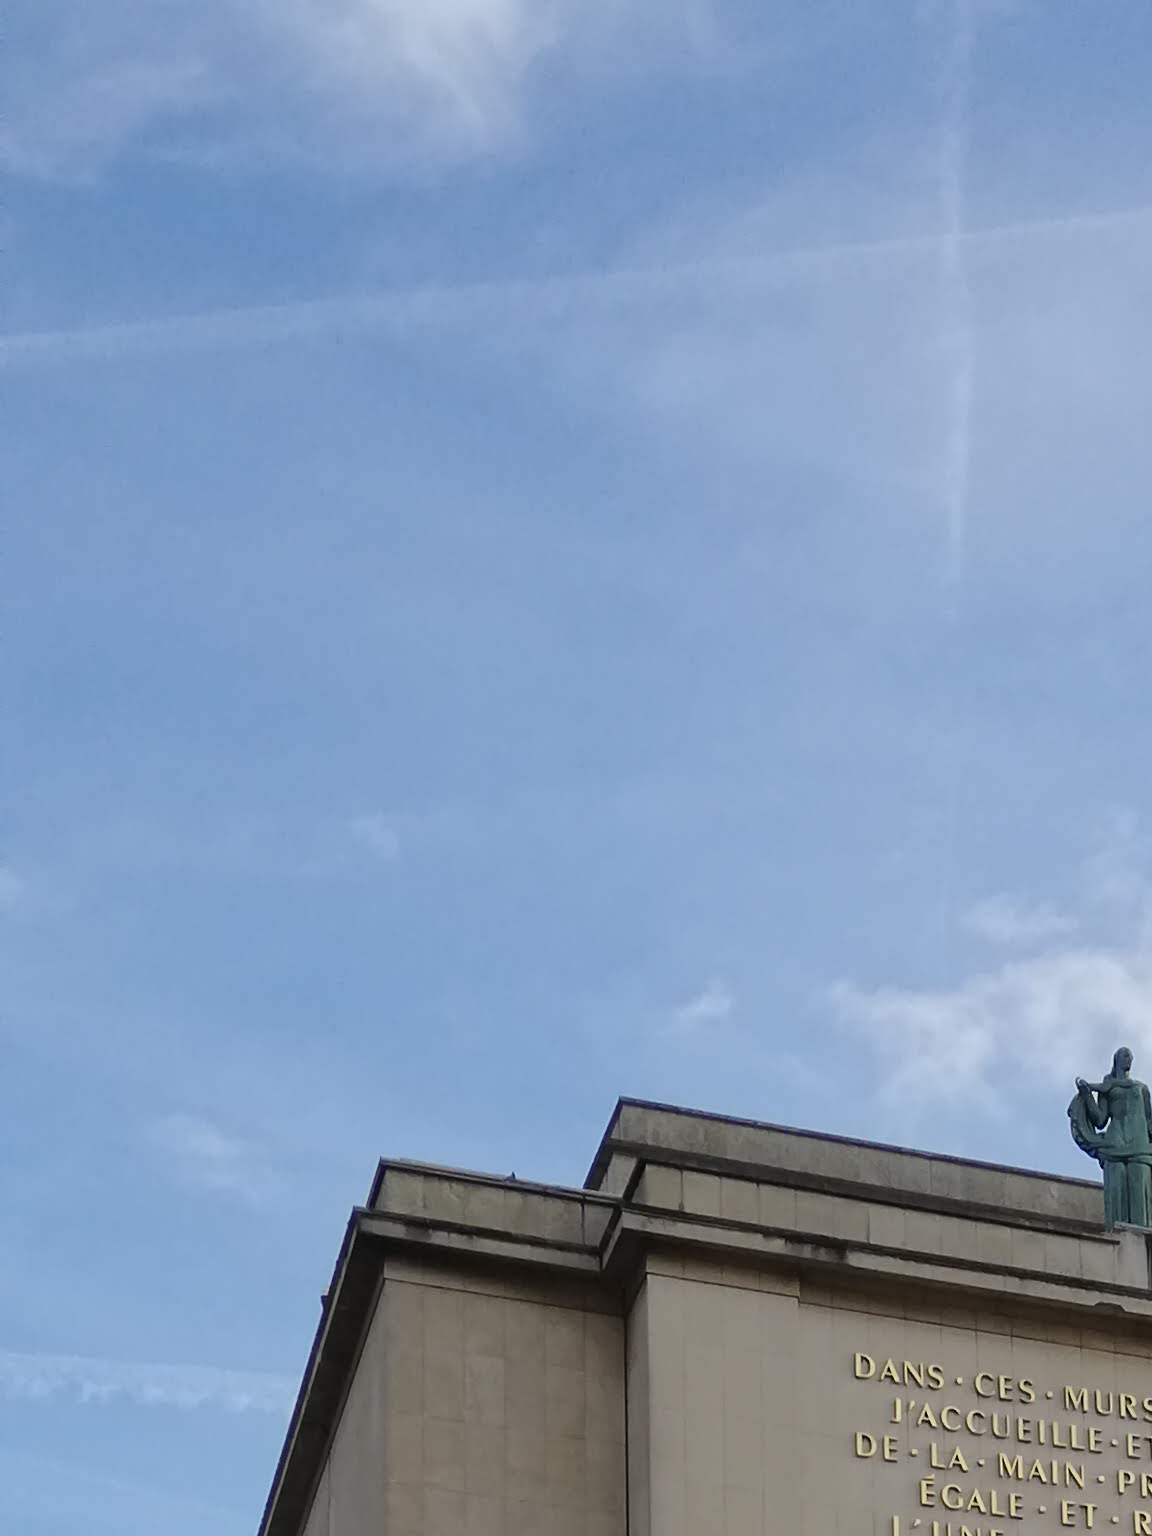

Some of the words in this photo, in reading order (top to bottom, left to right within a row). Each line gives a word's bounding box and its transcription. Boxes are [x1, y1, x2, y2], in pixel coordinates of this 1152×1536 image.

[854, 1352, 945, 1390] DANS
[975, 1373, 1036, 1403] CES
[890, 1397, 1104, 1454] J'ACCUEILLE
[854, 1432, 899, 1462] DE
[931, 1443, 969, 1472] LA
[999, 1452, 1086, 1489] MAIN
[920, 1474, 1025, 1519] ÉGALE
[1060, 1500, 1098, 1528] ET
